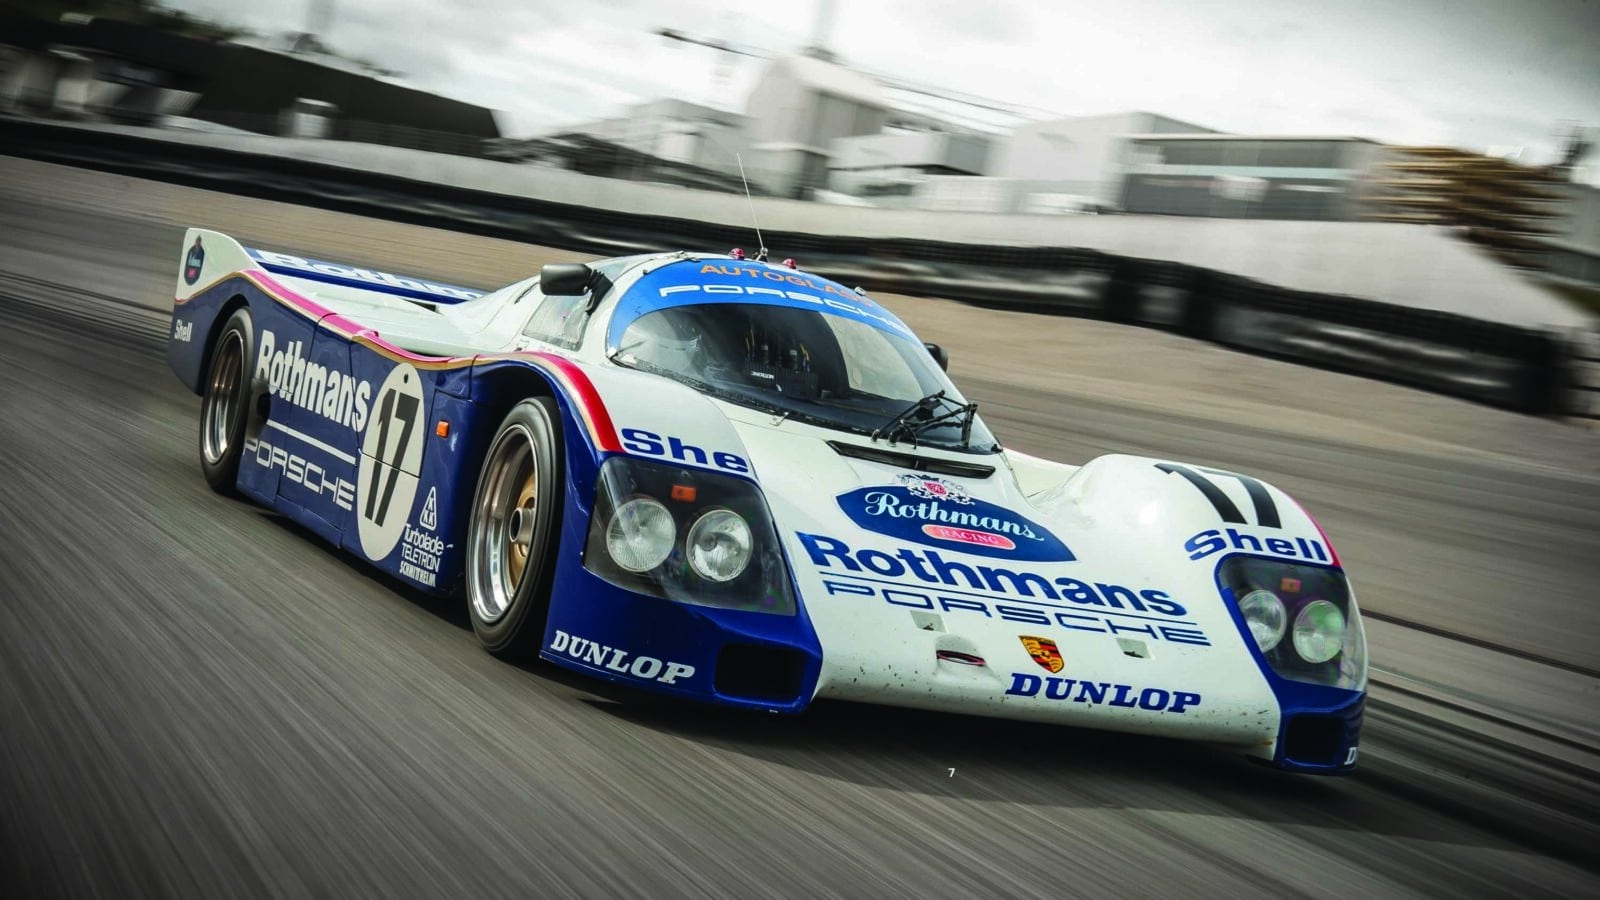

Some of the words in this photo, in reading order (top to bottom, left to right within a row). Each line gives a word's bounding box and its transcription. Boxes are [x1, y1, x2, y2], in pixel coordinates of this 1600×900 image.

[175, 319, 193, 342] Shell
[660, 285, 911, 333] PORSCHE
[256, 329, 371, 432] Rothmans
[243, 438, 356, 511] PORSCHE
[365, 388, 420, 527] 17
[865, 491, 1044, 542] Rothmans
[1153, 463, 1282, 529] 17
[402, 542, 440, 572] TELETRON
[940, 528, 999, 545] RACING
[1184, 528, 1328, 562] Shell
[795, 531, 1187, 616] Rothmans
[822, 580, 1212, 646] PORSCHE
[551, 630, 695, 684] DUNLOP
[1005, 672, 1200, 713] DUNLOP
